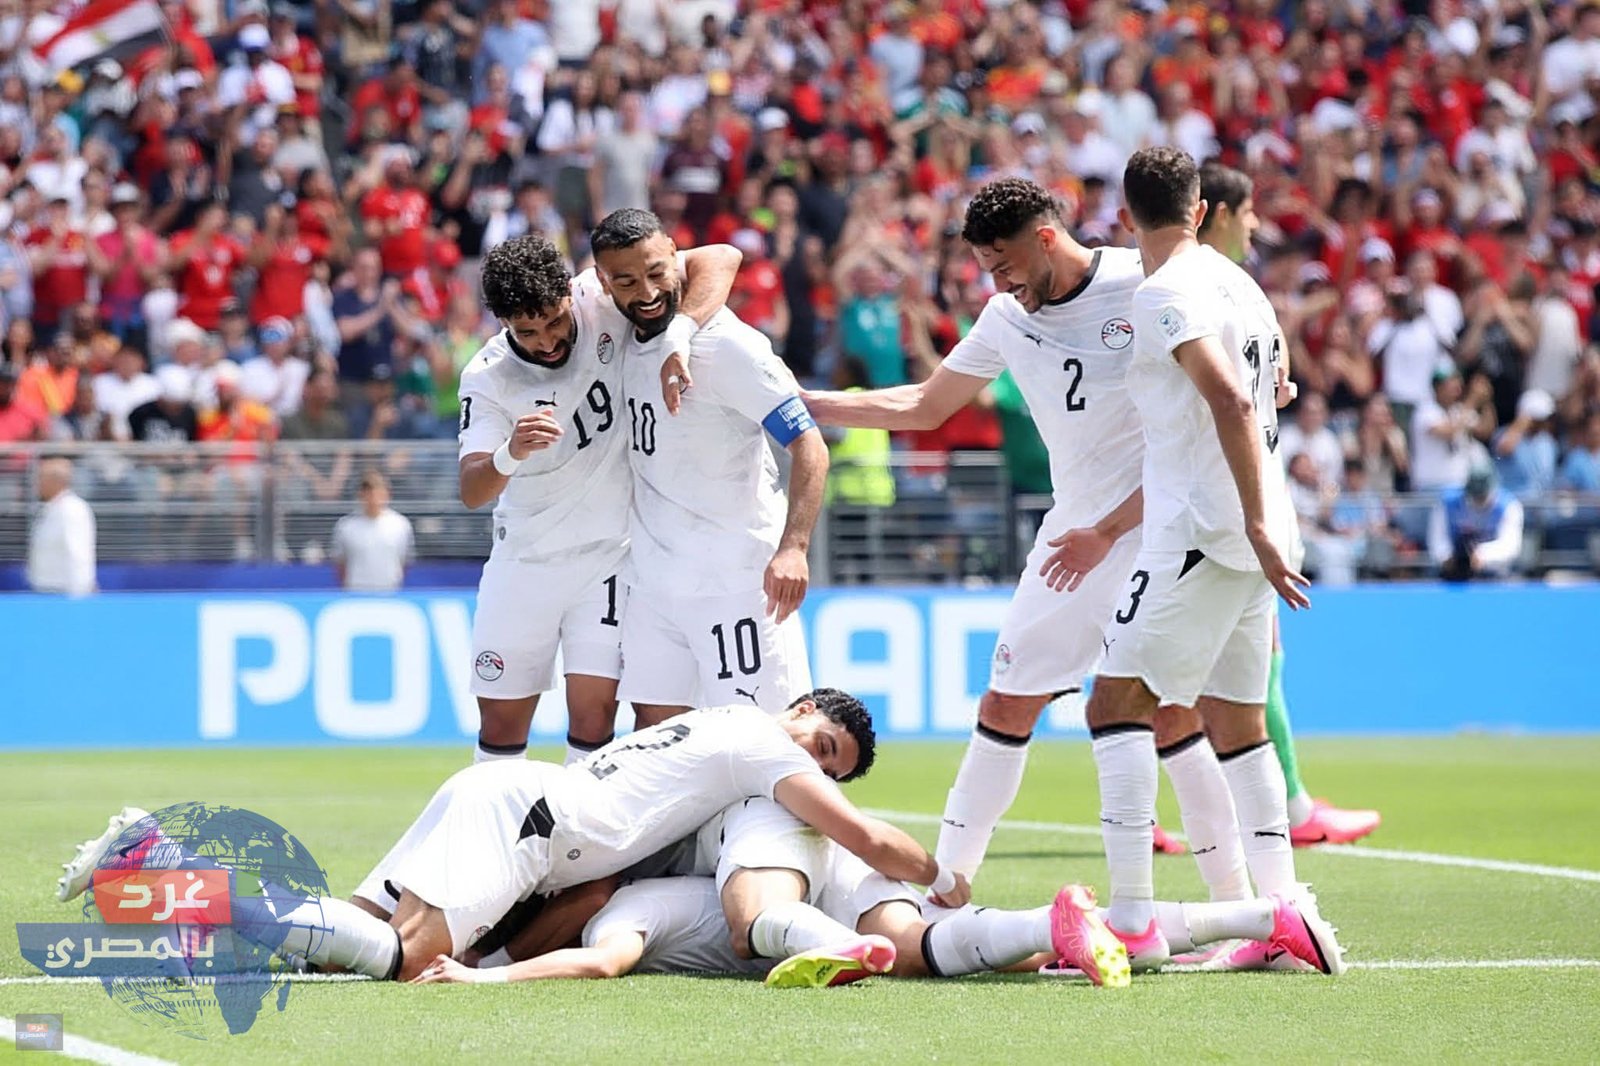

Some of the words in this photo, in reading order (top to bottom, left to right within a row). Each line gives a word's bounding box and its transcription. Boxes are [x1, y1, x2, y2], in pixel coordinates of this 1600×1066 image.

[1063, 358, 1086, 411] 2
[573, 379, 613, 450] 19
[628, 398, 657, 456] 10
[1115, 570, 1149, 624] 3
[711, 617, 761, 680] 10
